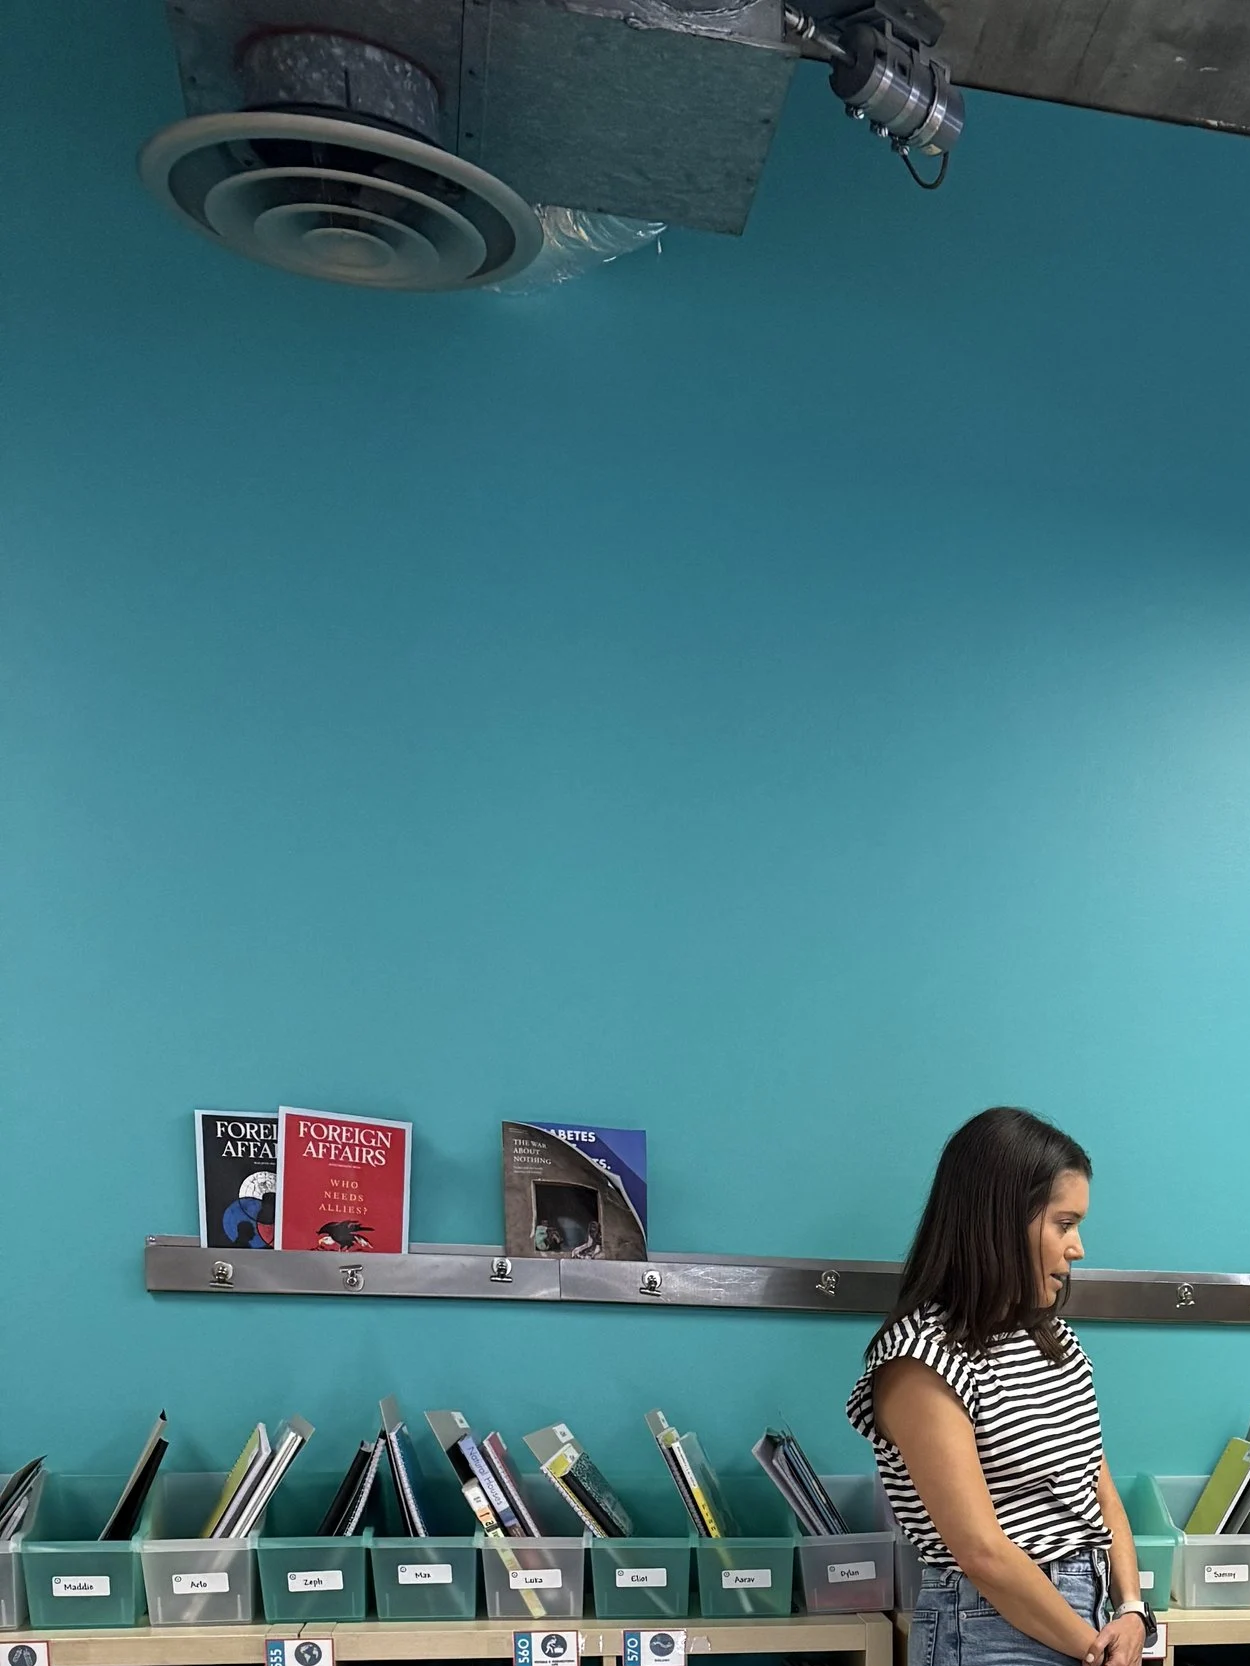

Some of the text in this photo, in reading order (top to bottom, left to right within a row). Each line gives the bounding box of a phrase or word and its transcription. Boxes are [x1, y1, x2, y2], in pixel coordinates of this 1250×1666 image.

[299, 1121, 393, 1148] FOREIGN
[303, 1143, 386, 1167] AFFAIRS
[513, 1147, 540, 1155] ABOUT
[513, 1155, 552, 1165] NOTHING
[331, 1179, 359, 1189] WHO
[325, 1191, 364, 1202] NEEDS
[319, 1203, 368, 1215] ALLIES?
[303, 1578, 323, 1587] Zeph
[518, 1638, 530, 1663] 560
[627, 1637, 639, 1662] 570
